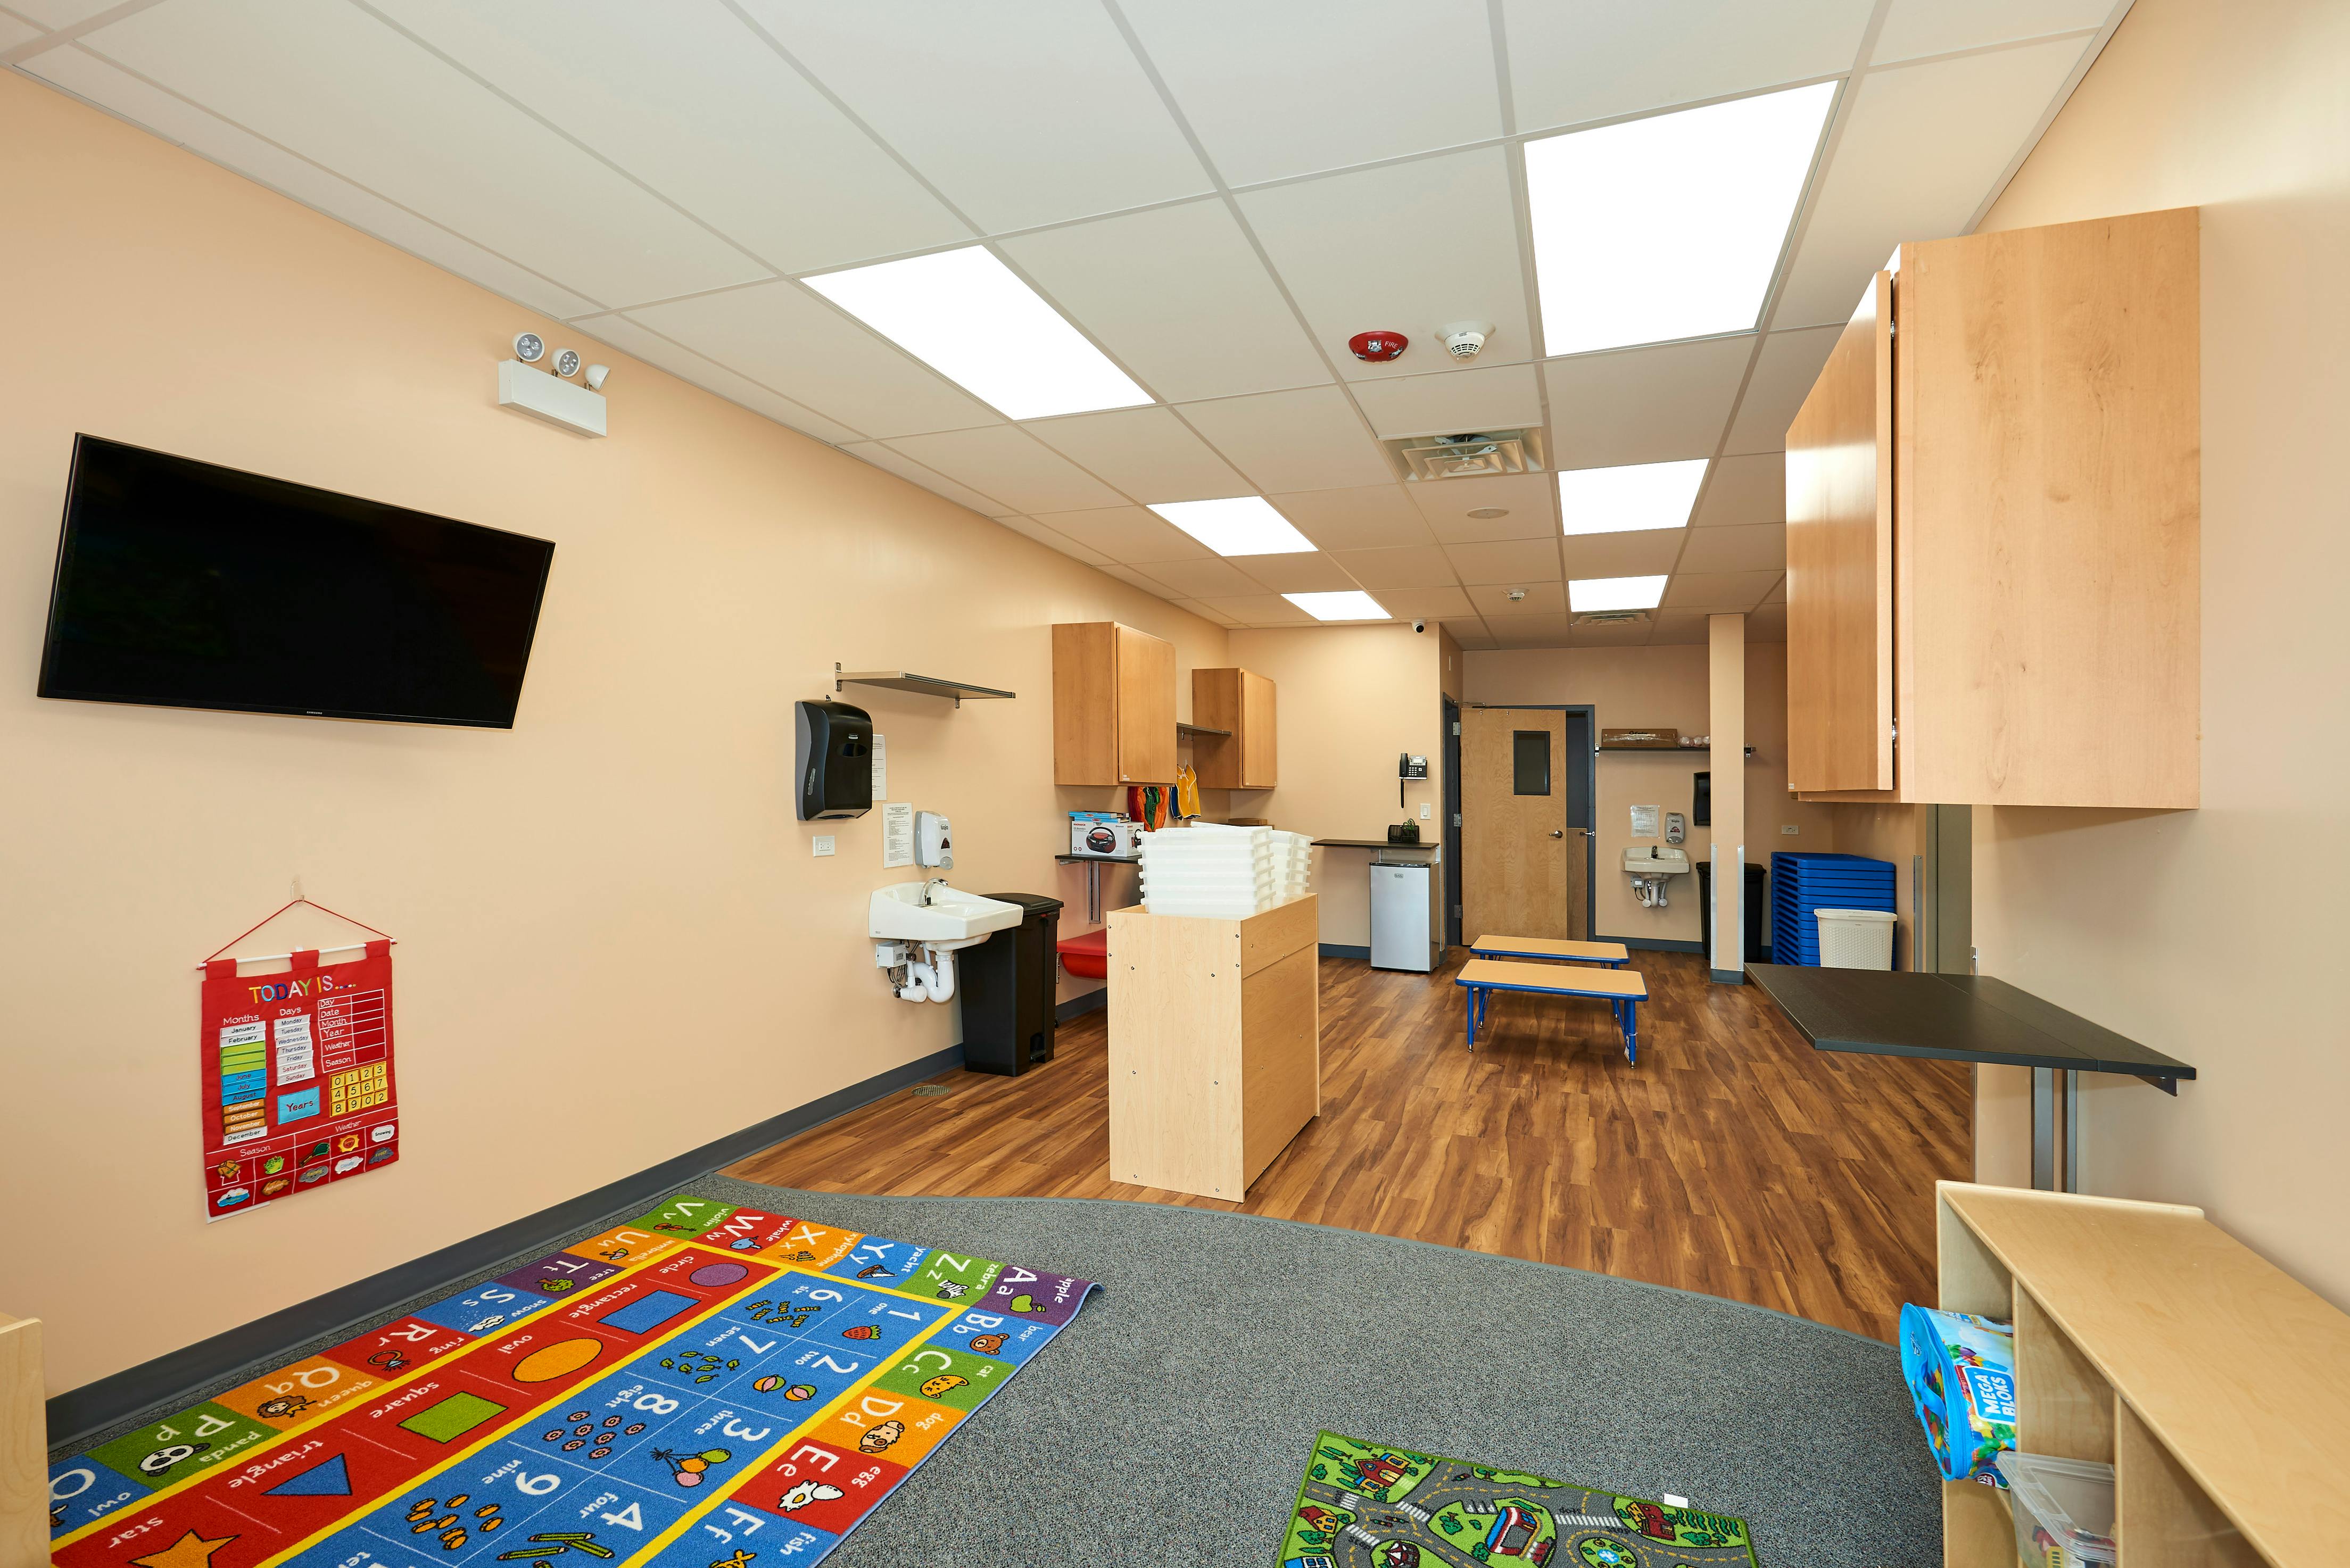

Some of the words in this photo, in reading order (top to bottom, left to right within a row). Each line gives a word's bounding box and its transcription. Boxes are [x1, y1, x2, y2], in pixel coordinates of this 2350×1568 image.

[249, 978, 312, 1004] TODAY
[223, 1015, 259, 1025] Months
[279, 1007, 301, 1016] Days
[321, 1009, 339, 1018] Date
[321, 1018, 347, 1027] Month
[228, 1034, 258, 1043] February
[278, 1035, 309, 1044] Wednesday
[324, 1028, 344, 1038] Year
[282, 1045, 307, 1053] Thursday
[325, 1041, 352, 1051] Weather
[283, 1063, 307, 1073] Saturday
[326, 1057, 351, 1067] Season
[228, 1101, 260, 1111] September
[286, 1100, 313, 1112] Years
[336, 1104, 341, 1113] 8
[230, 1111, 258, 1121] October
[230, 1121, 261, 1131] November
[335, 1121, 361, 1132] Weather
[228, 1130, 261, 1141] December
[240, 1146, 271, 1157] Season
[704, 1208, 729, 1227] violin
[766, 1219, 792, 1242] whale
[628, 1239, 675, 1262] umbrella
[817, 1232, 859, 1267] xylophone
[659, 1256, 694, 1274] circle
[901, 1247, 926, 1274] yacht
[589, 1268, 615, 1281] tree
[975, 1264, 999, 1290] zebra
[792, 1285, 809, 1295] six
[809, 1289, 843, 1302] 6
[1054, 1277, 1074, 1303] apple
[511, 1299, 547, 1317] snow
[569, 1283, 638, 1319] rectangle
[868, 1302, 888, 1315] one
[888, 1310, 921, 1321] 1
[706, 1326, 741, 1347] seven
[1020, 1326, 1043, 1342] bear
[429, 1337, 465, 1354] ring
[498, 1335, 532, 1354] oval
[739, 1335, 777, 1354] 7
[795, 1351, 820, 1365] two
[810, 1355, 858, 1373] 2
[977, 1365, 994, 1378] cat
[318, 1380, 373, 1408] queen
[370, 1382, 439, 1418] square
[605, 1385, 644, 1408] eight
[1975, 1375, 2001, 1414] MEGA
[1990, 1376, 2015, 1416] BLOKS
[633, 1393, 680, 1414] 8
[694, 1410, 734, 1435] three
[723, 1418, 771, 1441] 3
[915, 1413, 944, 1431] dog
[200, 1431, 263, 1463] panda
[228, 1440, 324, 1488] triangle
[482, 1459, 523, 1484] nine
[516, 1472, 560, 1495] 9
[851, 1466, 881, 1489] egg
[88, 1492, 131, 1516] owl
[579, 1492, 618, 1519] four
[600, 1501, 643, 1531] 4
[109, 1517, 163, 1548] star
[780, 1532, 816, 1555] fish
